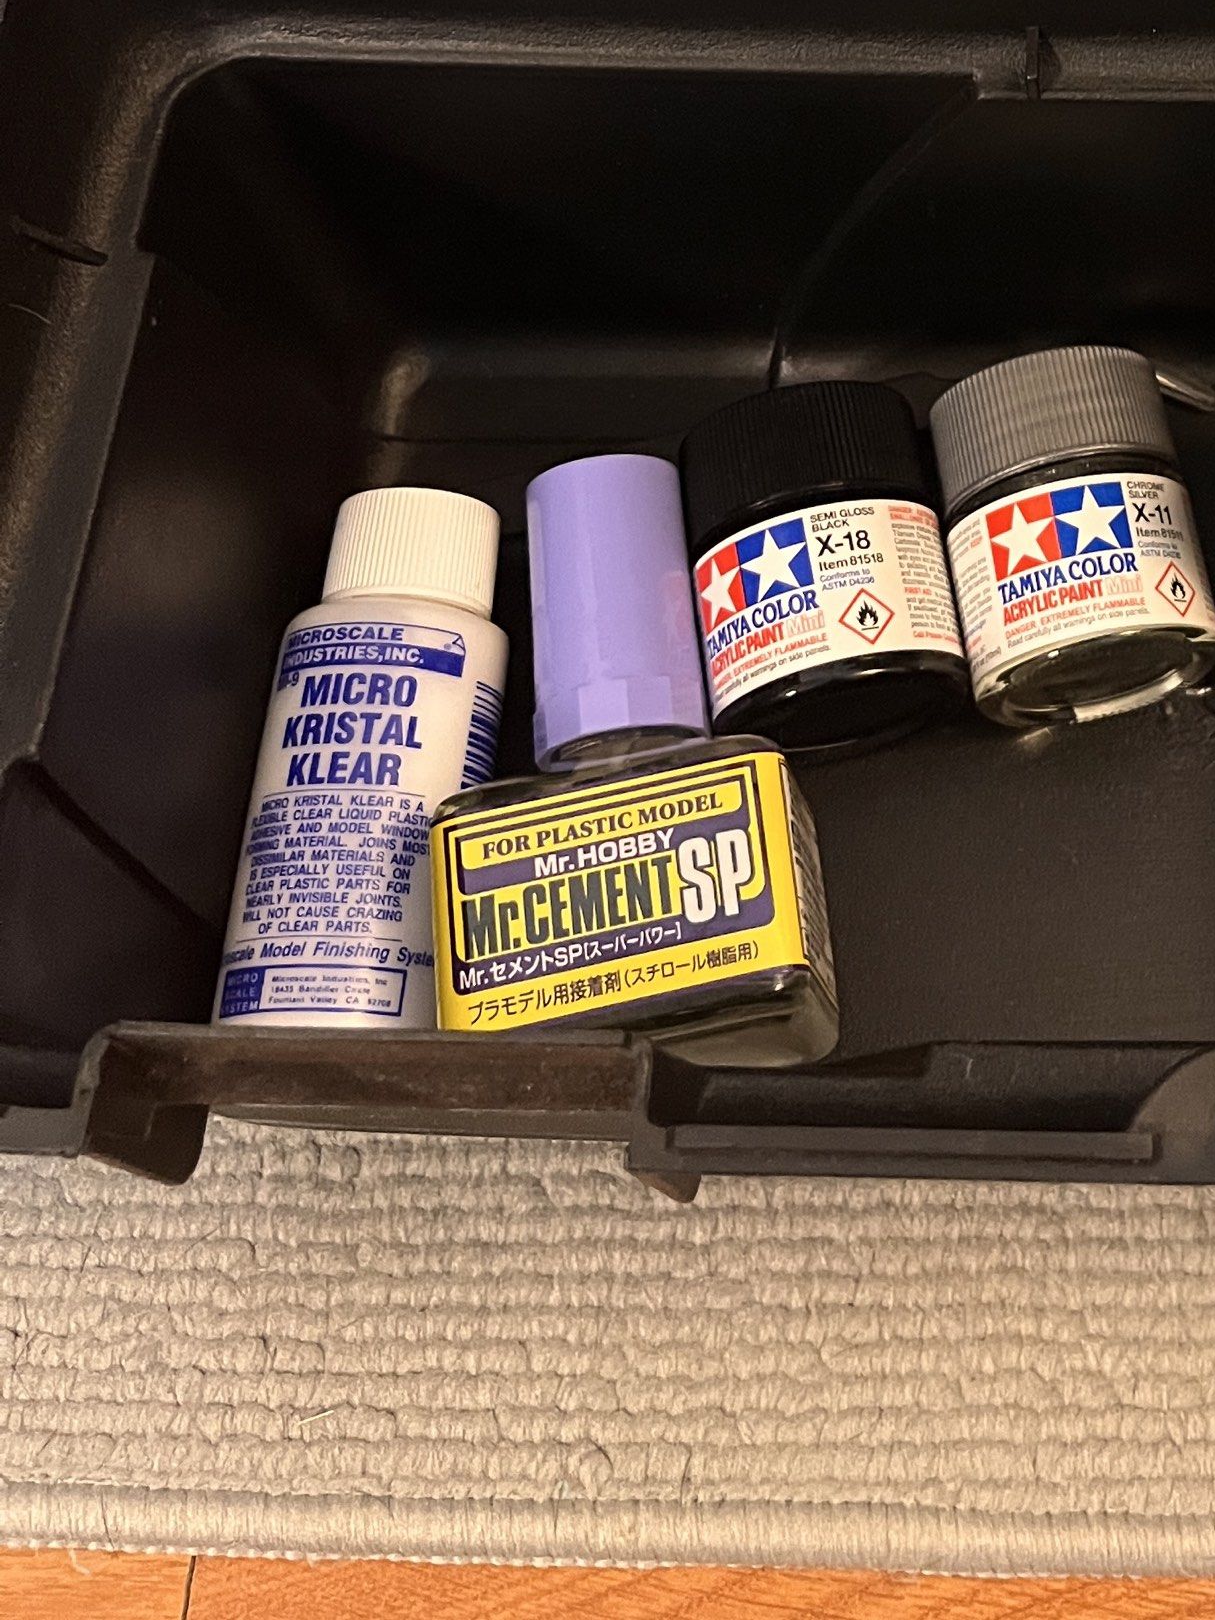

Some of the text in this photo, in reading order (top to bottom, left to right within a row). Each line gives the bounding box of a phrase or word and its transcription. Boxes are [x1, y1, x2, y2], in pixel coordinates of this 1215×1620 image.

[1127, 481, 1164, 492] CHROME
[1128, 489, 1159, 499] SILVER
[810, 510, 837, 523] SEMI
[839, 506, 875, 518] GLOSS
[1132, 502, 1172, 525] X-11
[811, 518, 850, 533] BLACK
[815, 529, 871, 558] X-18
[819, 552, 884, 572] Item 81518
[997, 564, 1068, 605] TAMIYA
[1068, 552, 1139, 581] COLOR
[1003, 573, 1143, 627] ACRYLIC PAINT Mini
[1040, 603, 1090, 626] EXTREMELY
[1093, 596, 1146, 613] FLAMMABLE
[707, 588, 820, 658] TAMIYA COLOR
[745, 621, 785, 655] PAINT
[786, 609, 825, 639] Mini
[287, 626, 404, 649] MICROSCALE
[774, 632, 828, 656] FLAMMABLE
[300, 672, 418, 708] MICRO
[281, 711, 422, 750] KRISTAL
[286, 751, 402, 788] KLEAR
[293, 794, 342, 807] KRISTAL
[350, 794, 394, 807] KLEAR
[400, 798, 411, 810] IS
[415, 801, 424, 812] A
[293, 807, 332, 820] CLEAR
[338, 807, 382, 820] LIQUID
[297, 822, 322, 834] AND
[328, 822, 373, 834] MODEL
[380, 823, 430, 841] WINDOW
[482, 791, 724, 861] FOR PLASTIC MODEL
[284, 835, 347, 849] MATERIAL.
[358, 836, 396, 850] JOINS
[534, 827, 675, 880] Mr.HOBBY
[311, 849, 384, 863] MATERIALS
[390, 853, 415, 867] AND
[260, 864, 330, 880] ESPECIALLY
[335, 864, 386, 878] USEFUL
[392, 867, 410, 880] ON
[678, 827, 754, 925] SP
[245, 877, 411, 896] CLEAR PLASTIC PARTS FOR
[246, 891, 403, 909] NEARLY INVISIBLE JOINTS.
[267, 906, 291, 919] NOT
[296, 905, 339, 918] CAUSE
[347, 906, 403, 922] CRAZING
[258, 920, 374, 935] OF CLEAR PARTS.
[260, 941, 306, 958] Model
[312, 941, 390, 964] Finishing
[396, 946, 434, 967] Syste
